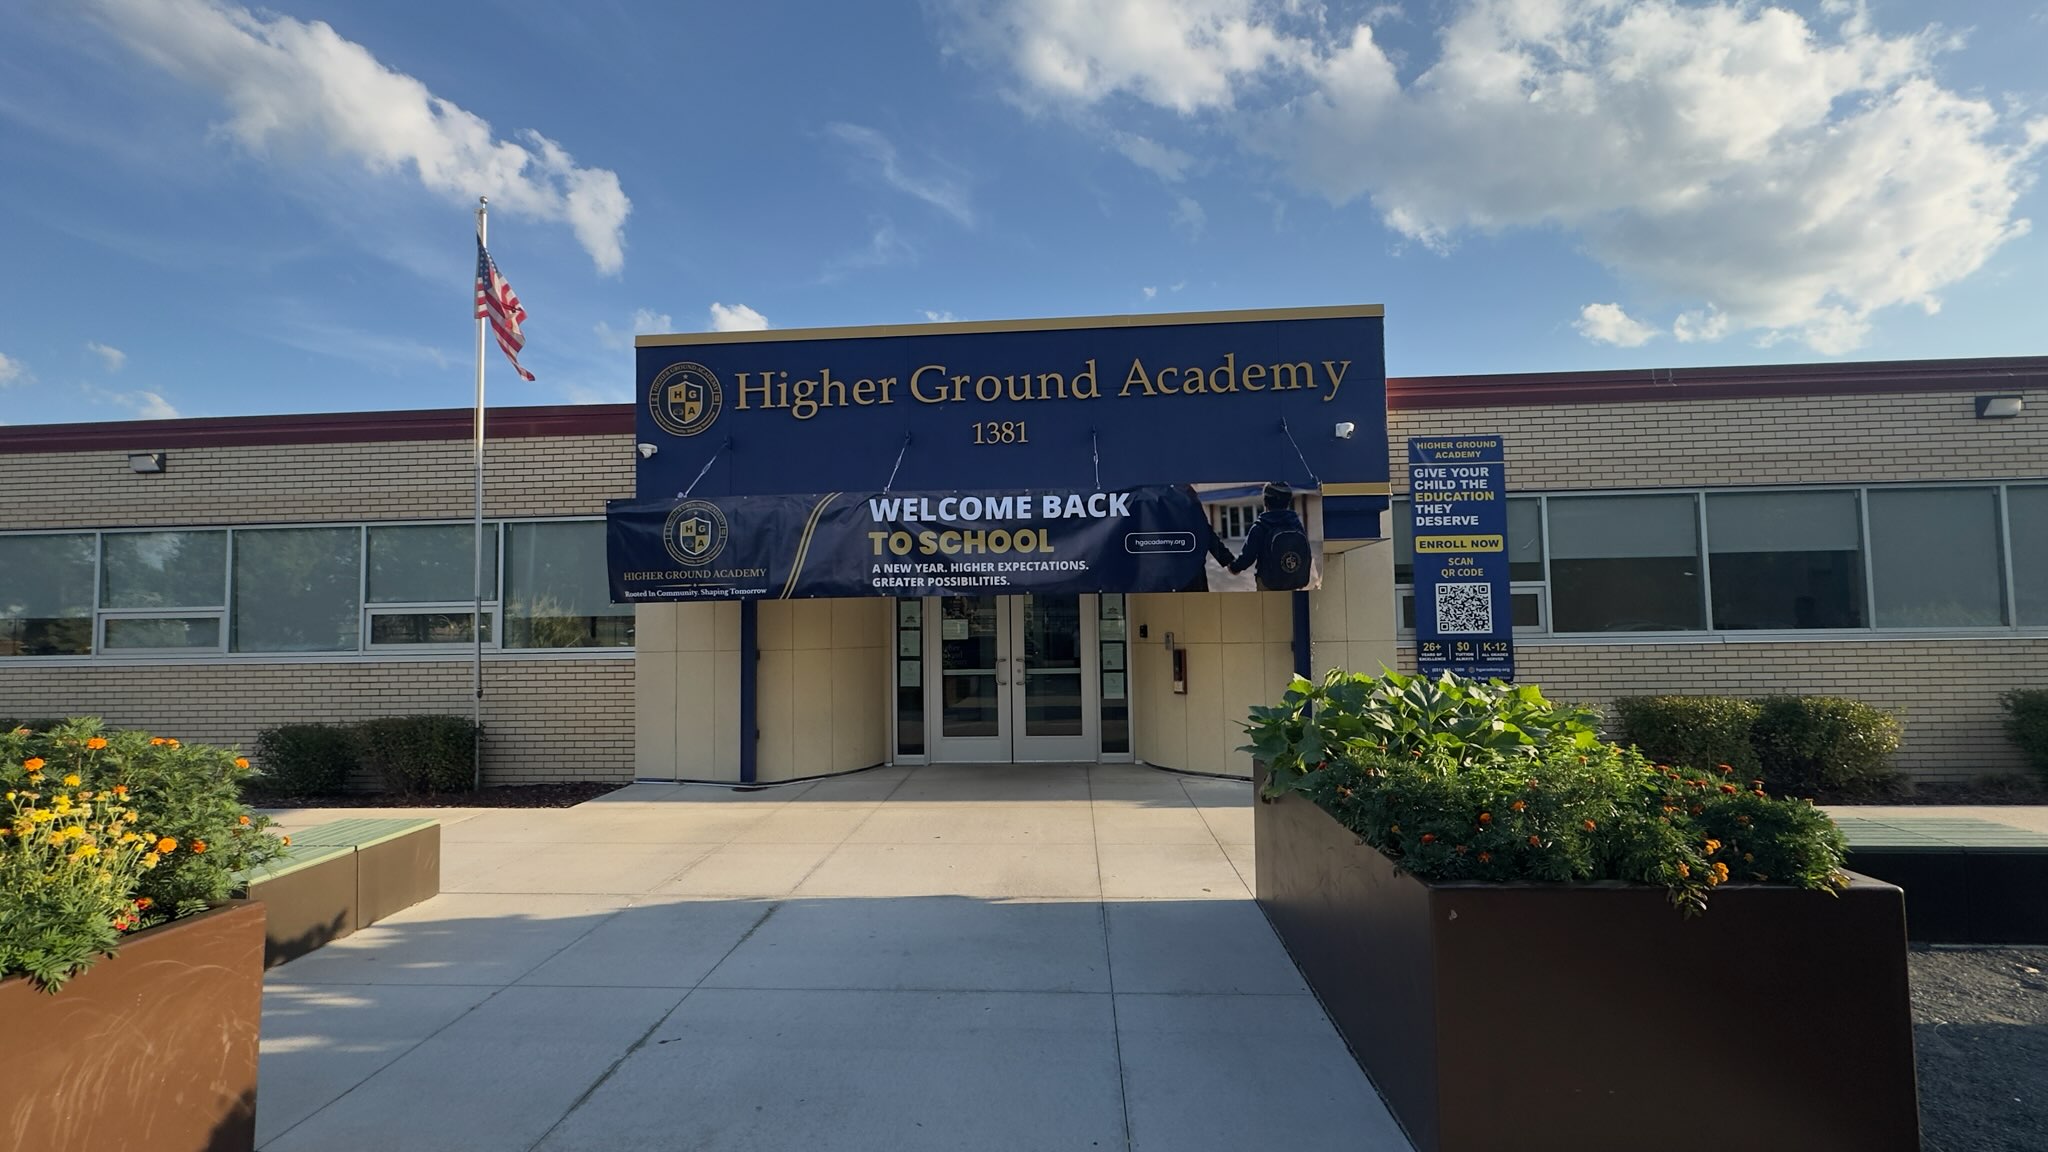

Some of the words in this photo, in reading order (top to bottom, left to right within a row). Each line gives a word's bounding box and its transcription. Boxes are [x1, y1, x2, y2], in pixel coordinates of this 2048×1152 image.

[734, 368, 897, 420] Higher
[910, 359, 1101, 404] Ground
[1118, 353, 1351, 401] Academy
[674, 391, 682, 399] H
[688, 390, 697, 399] G
[687, 406, 696, 415] A
[971, 421, 1029, 445] 1381
[1456, 440, 1497, 448] GROUND
[1435, 451, 1482, 459] ACADEMY
[1414, 468, 1447, 478] GIVE
[1451, 467, 1489, 477] YOUR
[1414, 480, 1456, 490] CHILD
[1460, 479, 1488, 489] THE
[1415, 491, 1495, 502] EDUCATION
[869, 496, 1032, 522] WELCOME
[1042, 493, 1131, 518] BACK
[1415, 504, 1453, 514] THEY
[1416, 516, 1479, 526] DESERVE
[685, 525, 693, 533] H
[698, 525, 706, 533] G
[868, 531, 913, 556] TO
[918, 528, 1055, 555] SCHOOL
[1135, 539, 1186, 547] hgacademy.org
[1419, 541, 1467, 549] ENROLL
[1471, 540, 1499, 548] NOW
[872, 563, 881, 574] A
[884, 563, 912, 573] NEW
[914, 563, 948, 573] YEAR.
[950, 562, 995, 573] HIGHER
[997, 560, 1090, 571] EXPECTATIONS.
[1448, 558, 1474, 566] SCAN
[623, 571, 664, 581] HIGHER
[665, 570, 711, 579] GROUND
[712, 568, 767, 578] ACADEMY
[1441, 569, 1455, 578] QR
[1457, 568, 1484, 577] CODE
[872, 577, 924, 588] GREATER
[927, 575, 1011, 587] POSSIBILITIES.
[624, 590, 648, 598] Rooted
[700, 588, 729, 597] Shaping
[729, 587, 768, 595] Tomorrow
[1423, 642, 1441, 652] 26+
[1456, 641, 1470, 652] $0
[1483, 642, 1507, 651] K-12
